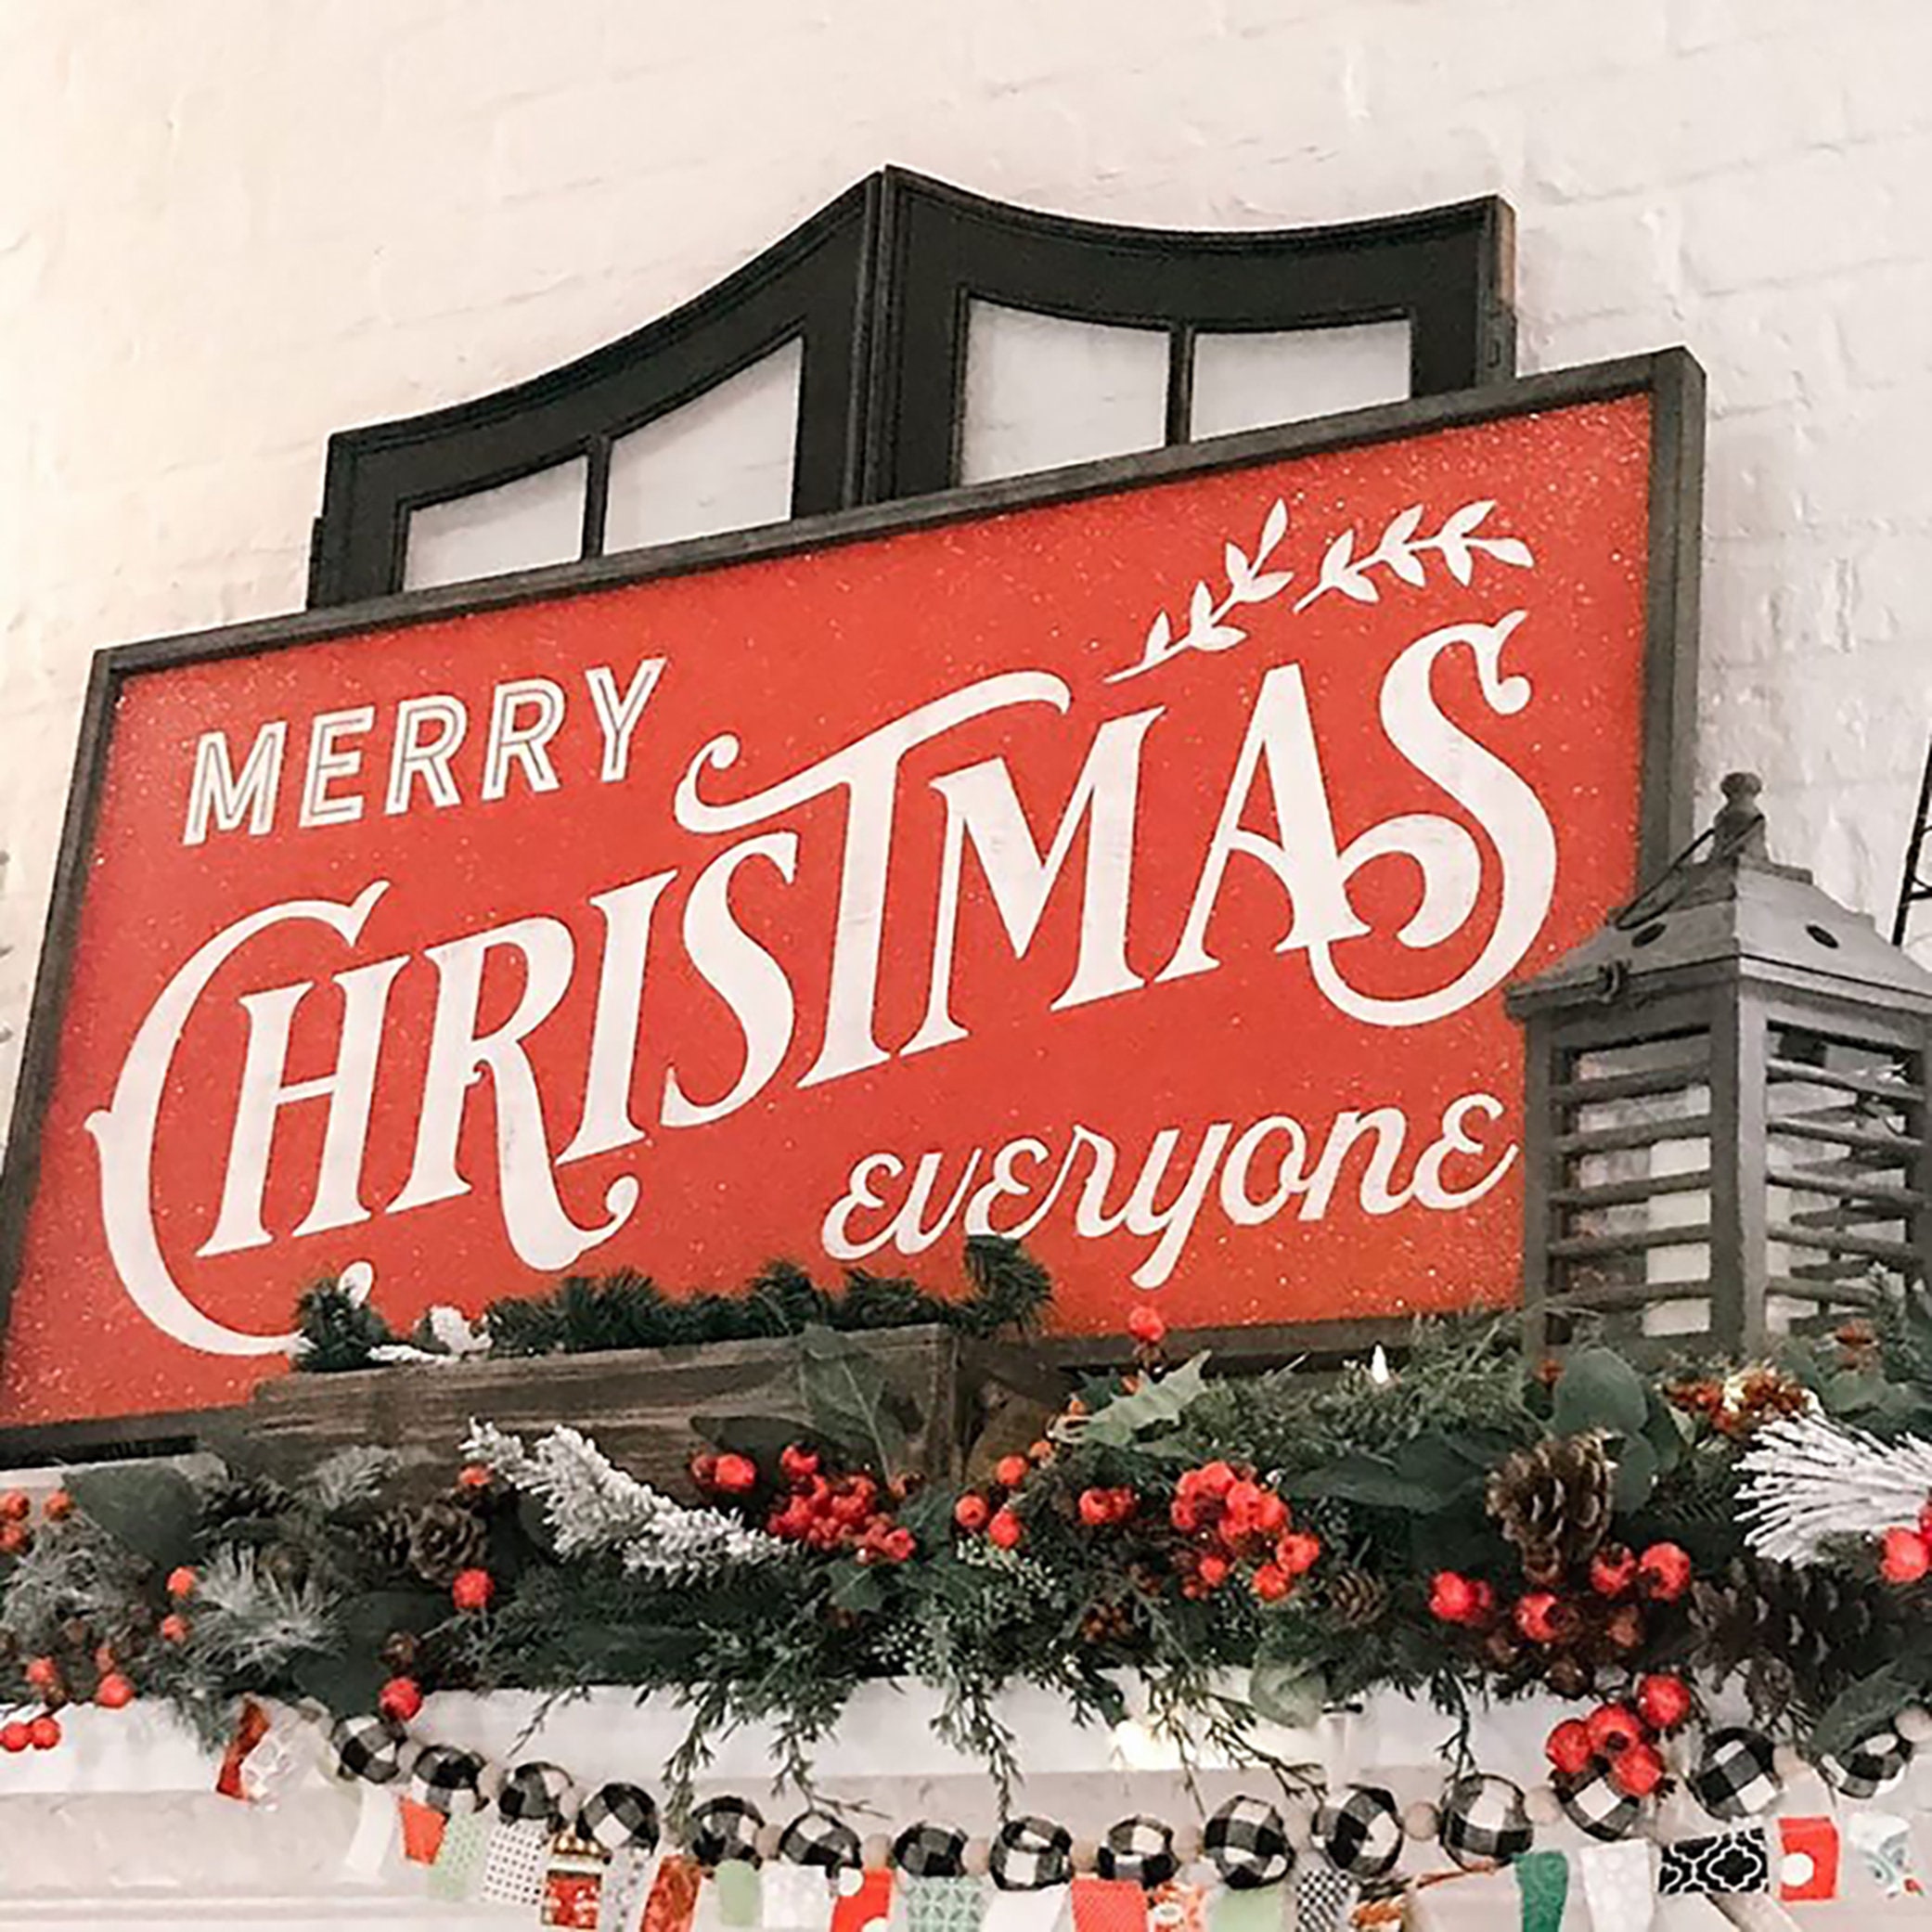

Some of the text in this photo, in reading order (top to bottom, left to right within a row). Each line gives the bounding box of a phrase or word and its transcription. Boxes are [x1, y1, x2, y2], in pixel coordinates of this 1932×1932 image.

[183, 657, 667, 846] MERRY
[84, 610, 1558, 1357] CHRISTMAS
[821, 1093, 1519, 1290] everyone
